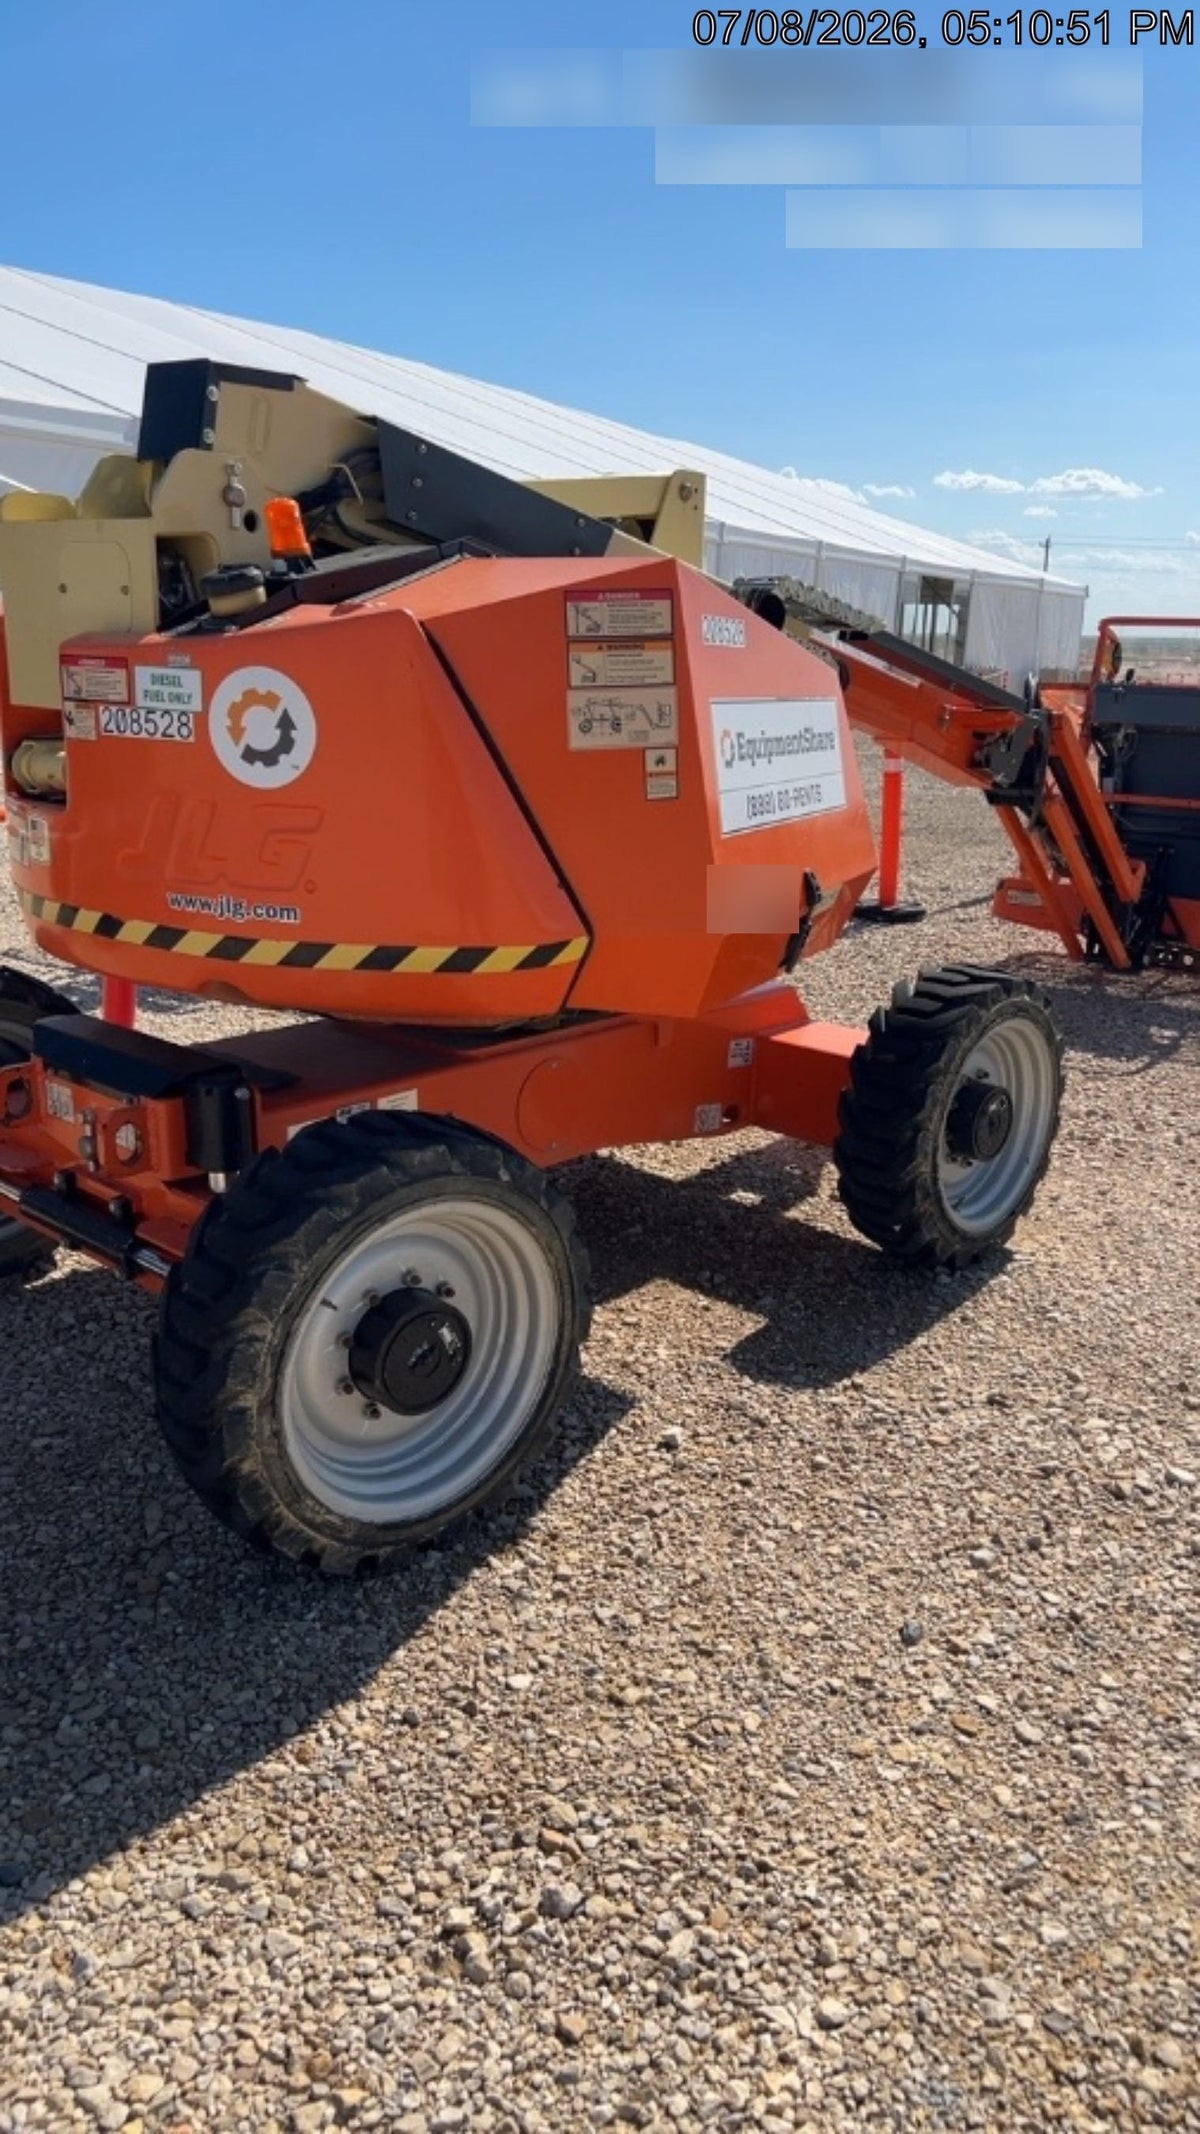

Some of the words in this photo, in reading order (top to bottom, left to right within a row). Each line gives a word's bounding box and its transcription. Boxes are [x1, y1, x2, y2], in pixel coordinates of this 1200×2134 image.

[151, 673, 183, 688] DIESEL
[144, 690, 165, 703] FUEL
[168, 692, 193, 705] ONLY
[101, 705, 192, 740] 208528
[736, 727, 836, 767] EquipmentShare
[167, 892, 300, 922] www.jlg.com
